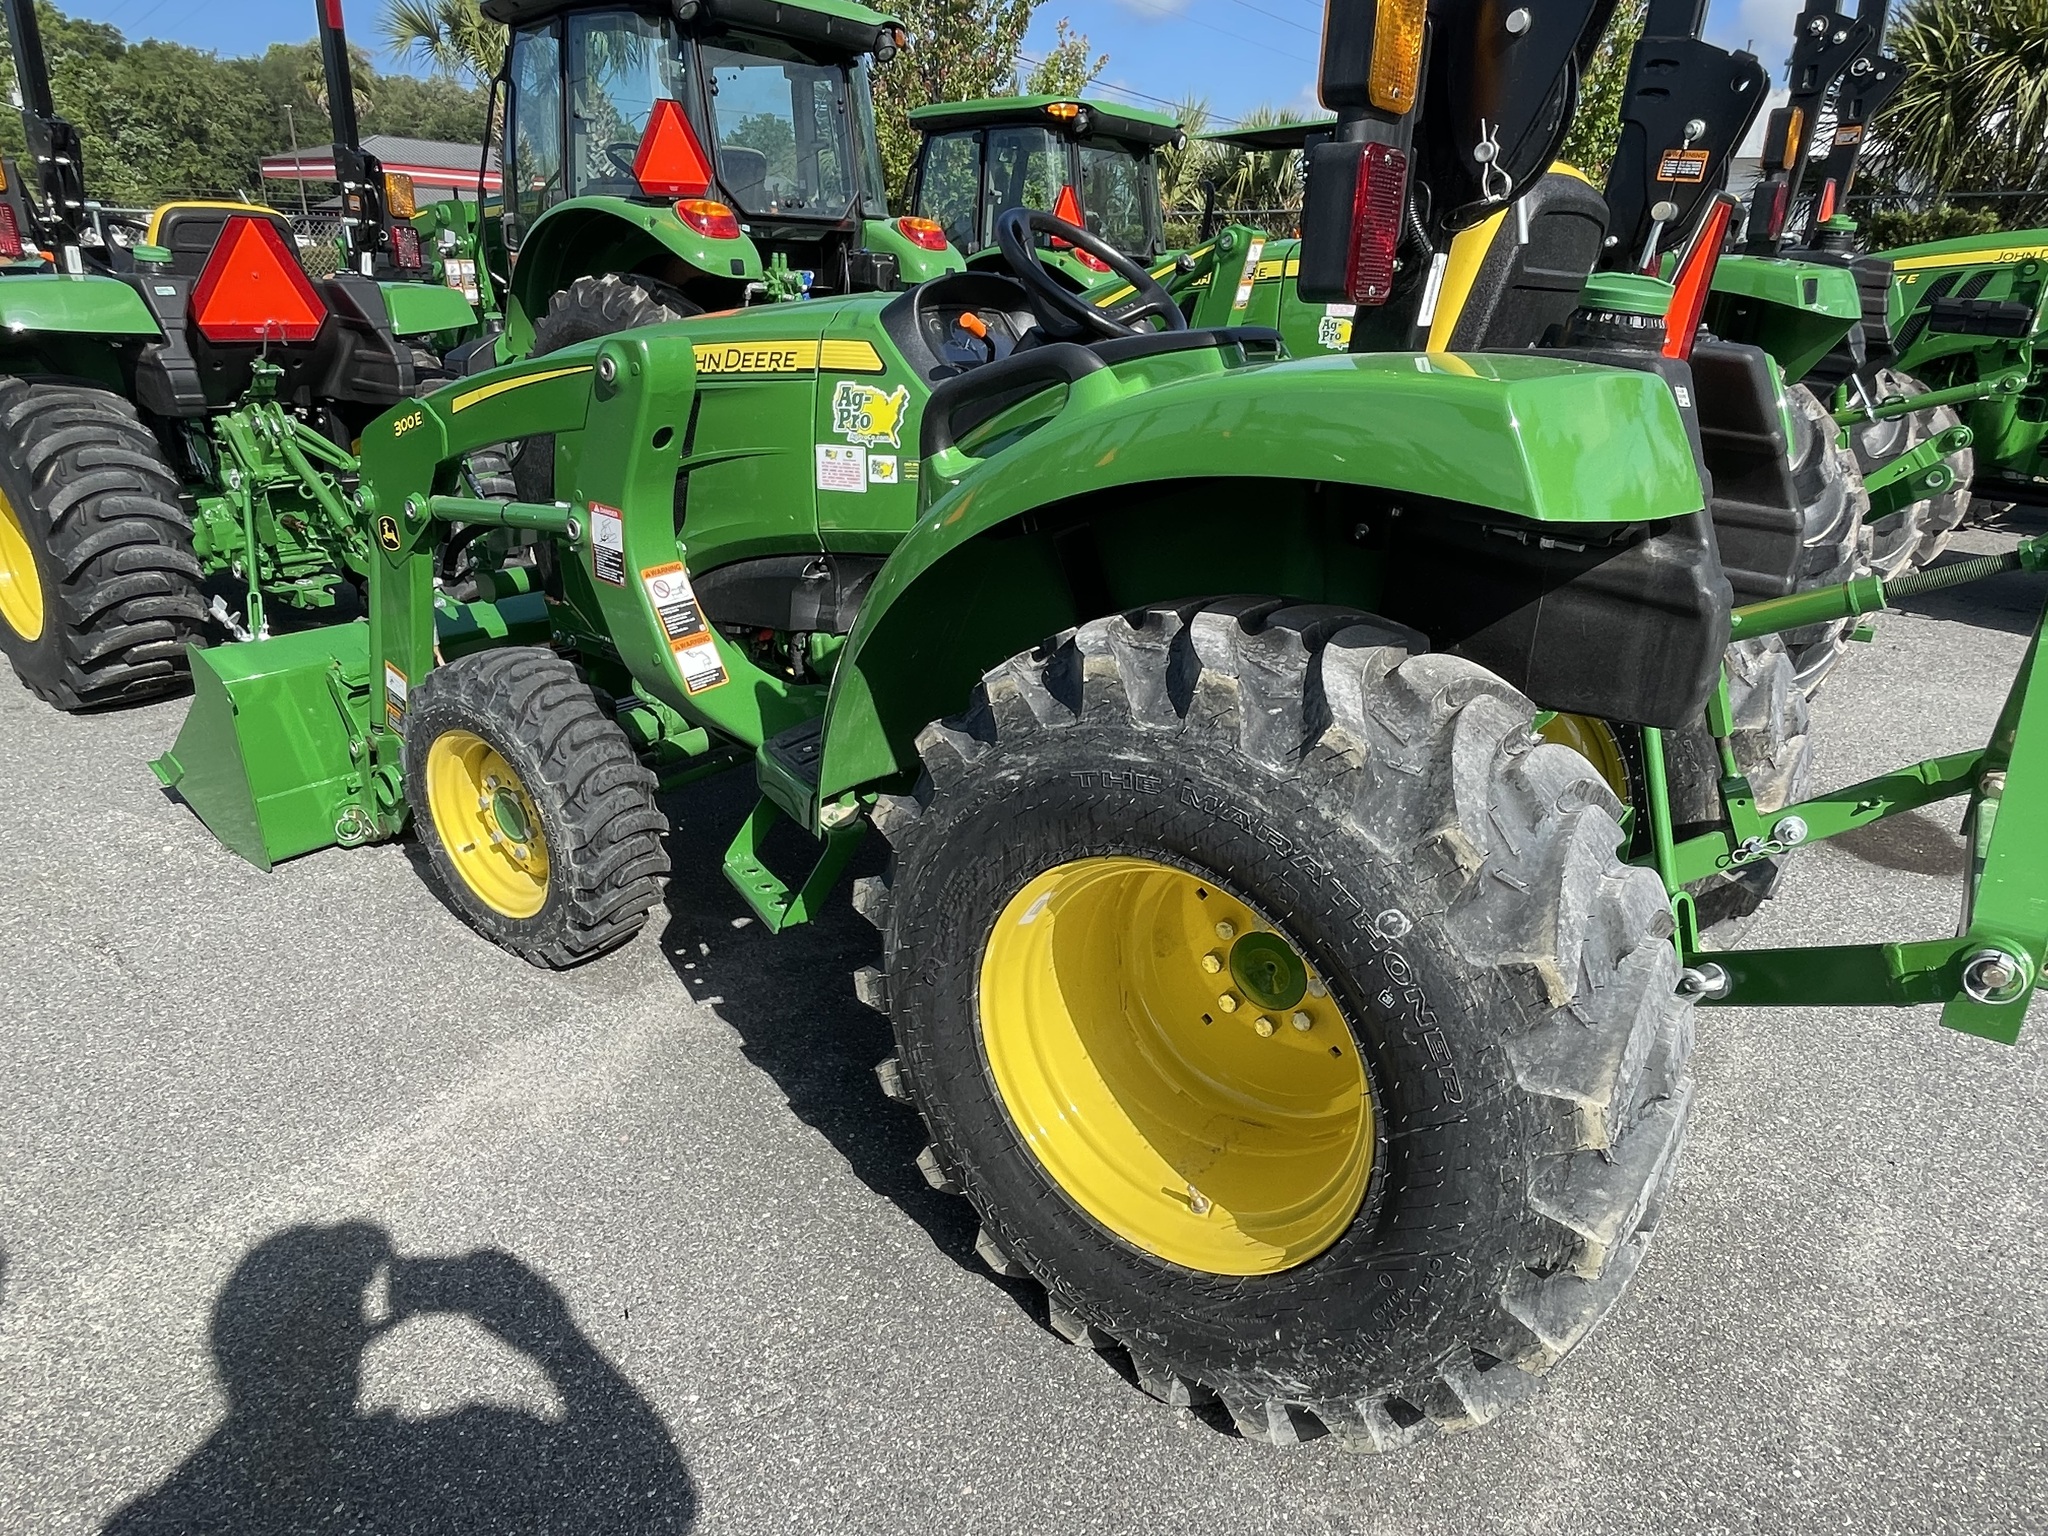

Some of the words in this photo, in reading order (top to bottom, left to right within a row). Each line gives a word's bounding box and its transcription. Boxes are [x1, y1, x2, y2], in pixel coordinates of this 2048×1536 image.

[1993, 251, 2037, 262] JOHN
[1321, 319, 1342, 332] Ag-
[1321, 331, 1342, 342] Pro
[695, 352, 722, 369] HN
[724, 348, 798, 369] DEERE
[837, 386, 871, 412] Ag-
[837, 408, 871, 429] Pro
[650, 563, 682, 578] WARNING
[679, 635, 711, 650] WARNING
[1070, 770, 1162, 795] THE
[1180, 785, 1464, 1104] MARATHONER
